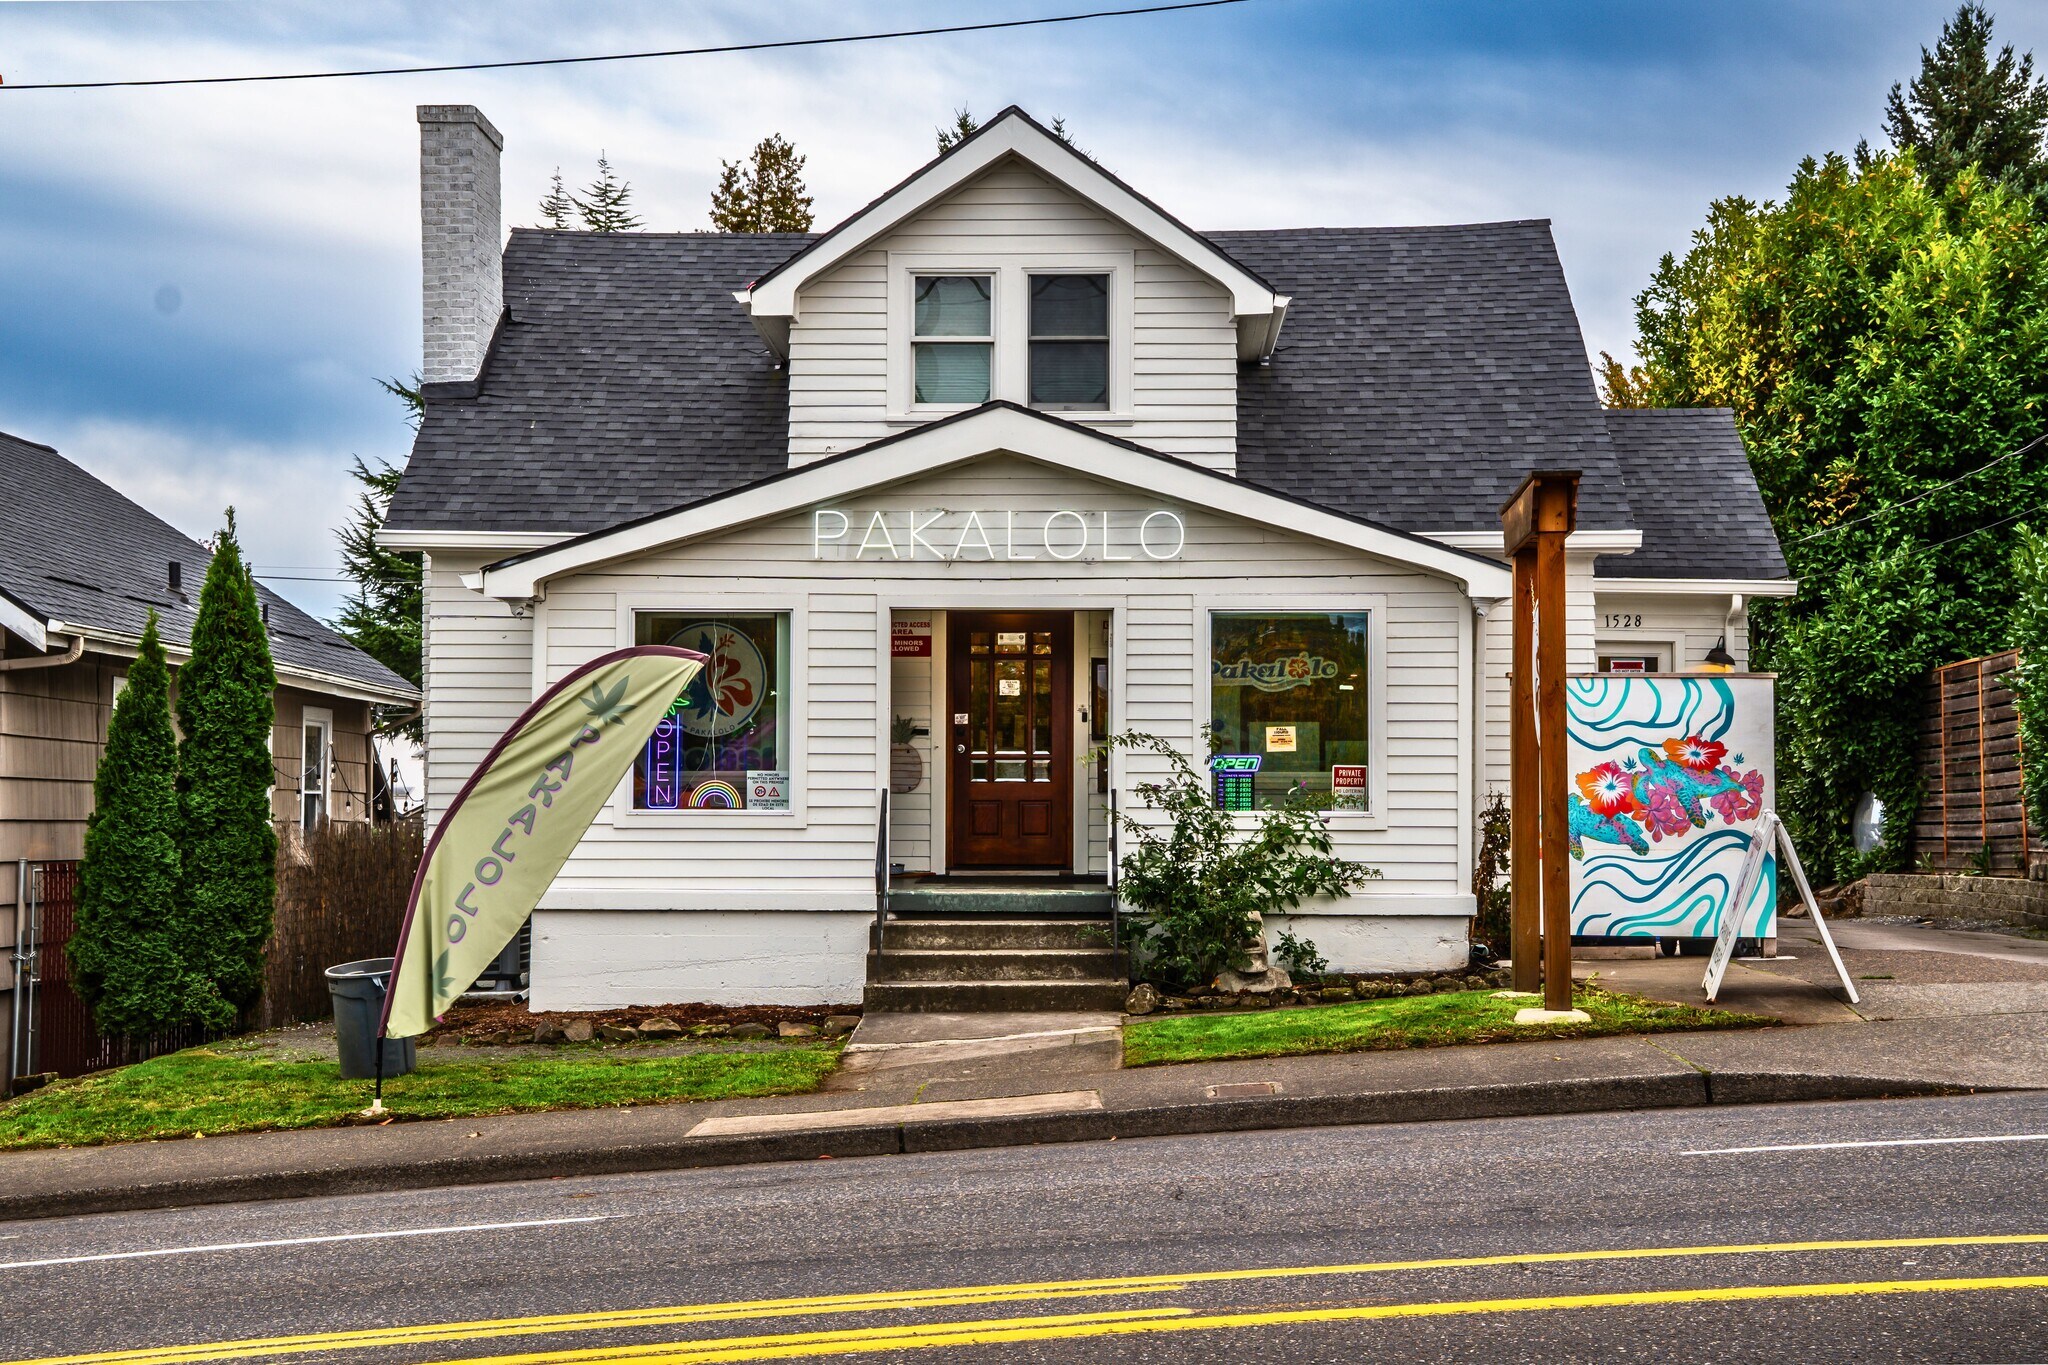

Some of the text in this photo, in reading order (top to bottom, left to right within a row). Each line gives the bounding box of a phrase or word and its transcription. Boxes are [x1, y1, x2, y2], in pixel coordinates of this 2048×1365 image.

[814, 509, 1185, 560] PAKALOLO
[1605, 614, 1642, 628] 1528
[690, 725, 736, 736] PAKALOLO
[655, 719, 673, 804] OPEN
[1213, 758, 1259, 769] OPEN
[1338, 769, 1362, 777] PRIVATE
[1335, 777, 1364, 785] PROPERTY
[446, 722, 601, 944] PAKALOLO
